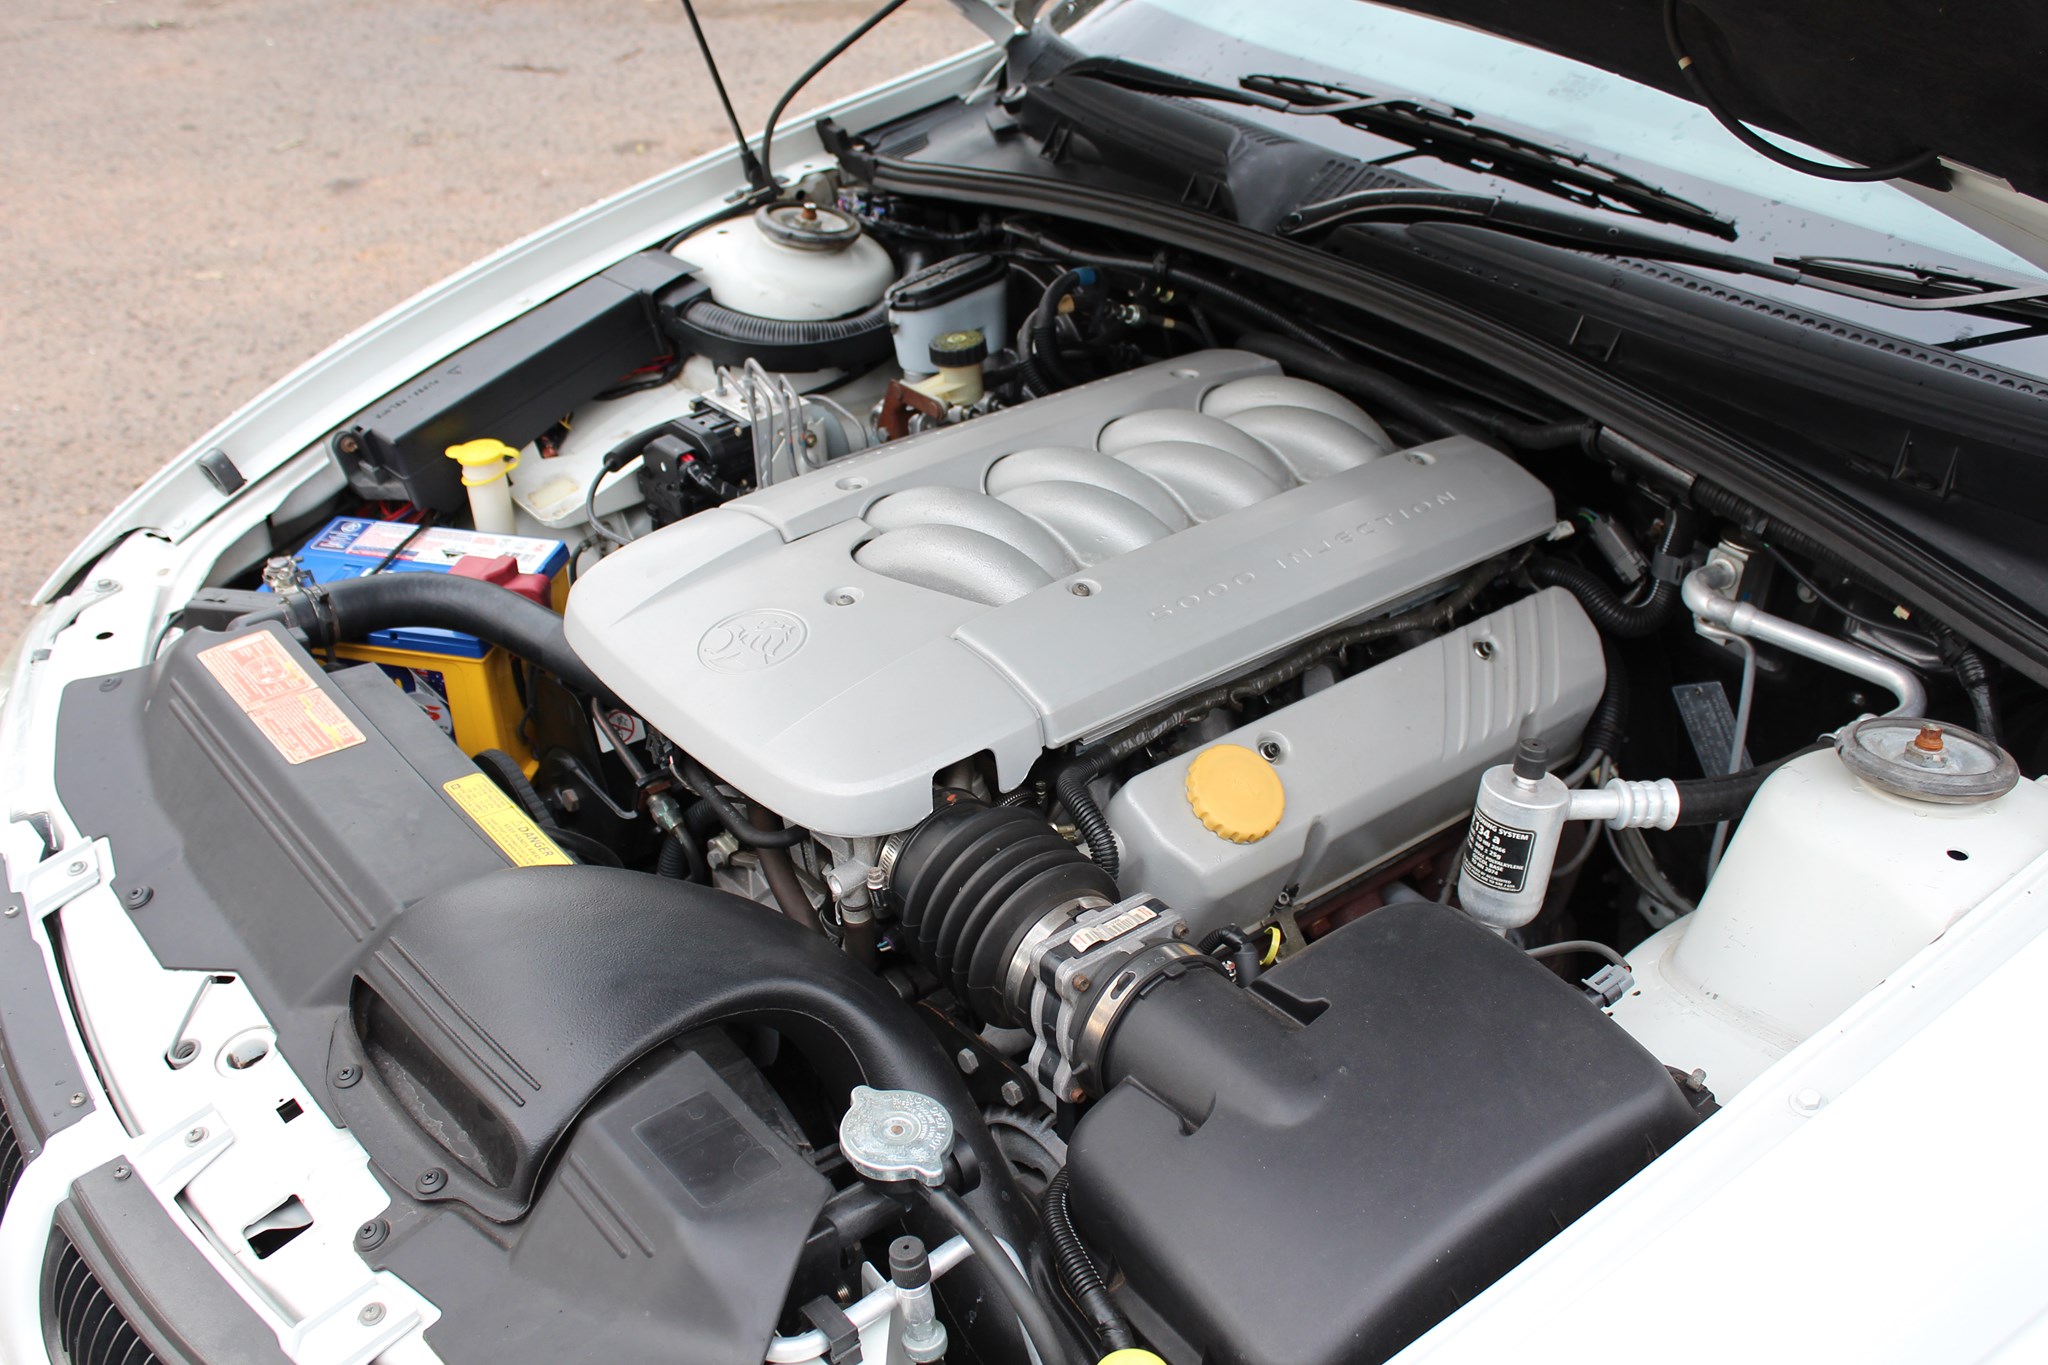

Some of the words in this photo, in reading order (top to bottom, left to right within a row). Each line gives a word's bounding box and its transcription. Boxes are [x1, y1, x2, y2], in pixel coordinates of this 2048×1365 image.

[1147, 572, 1256, 622] 5000
[1274, 491, 1457, 569] INJECTION
[519, 827, 554, 856] DANGER
[1475, 822, 1490, 839] 134
[1492, 836, 1500, 844] a
[1498, 829, 1529, 841] SYSTEM
[1489, 850, 1502, 860] 25g
[1489, 863, 1504, 872] BASE
[907, 1094, 930, 1106] NOT
[930, 1107, 947, 1129] OPEN
[929, 1132, 946, 1150] HOT
